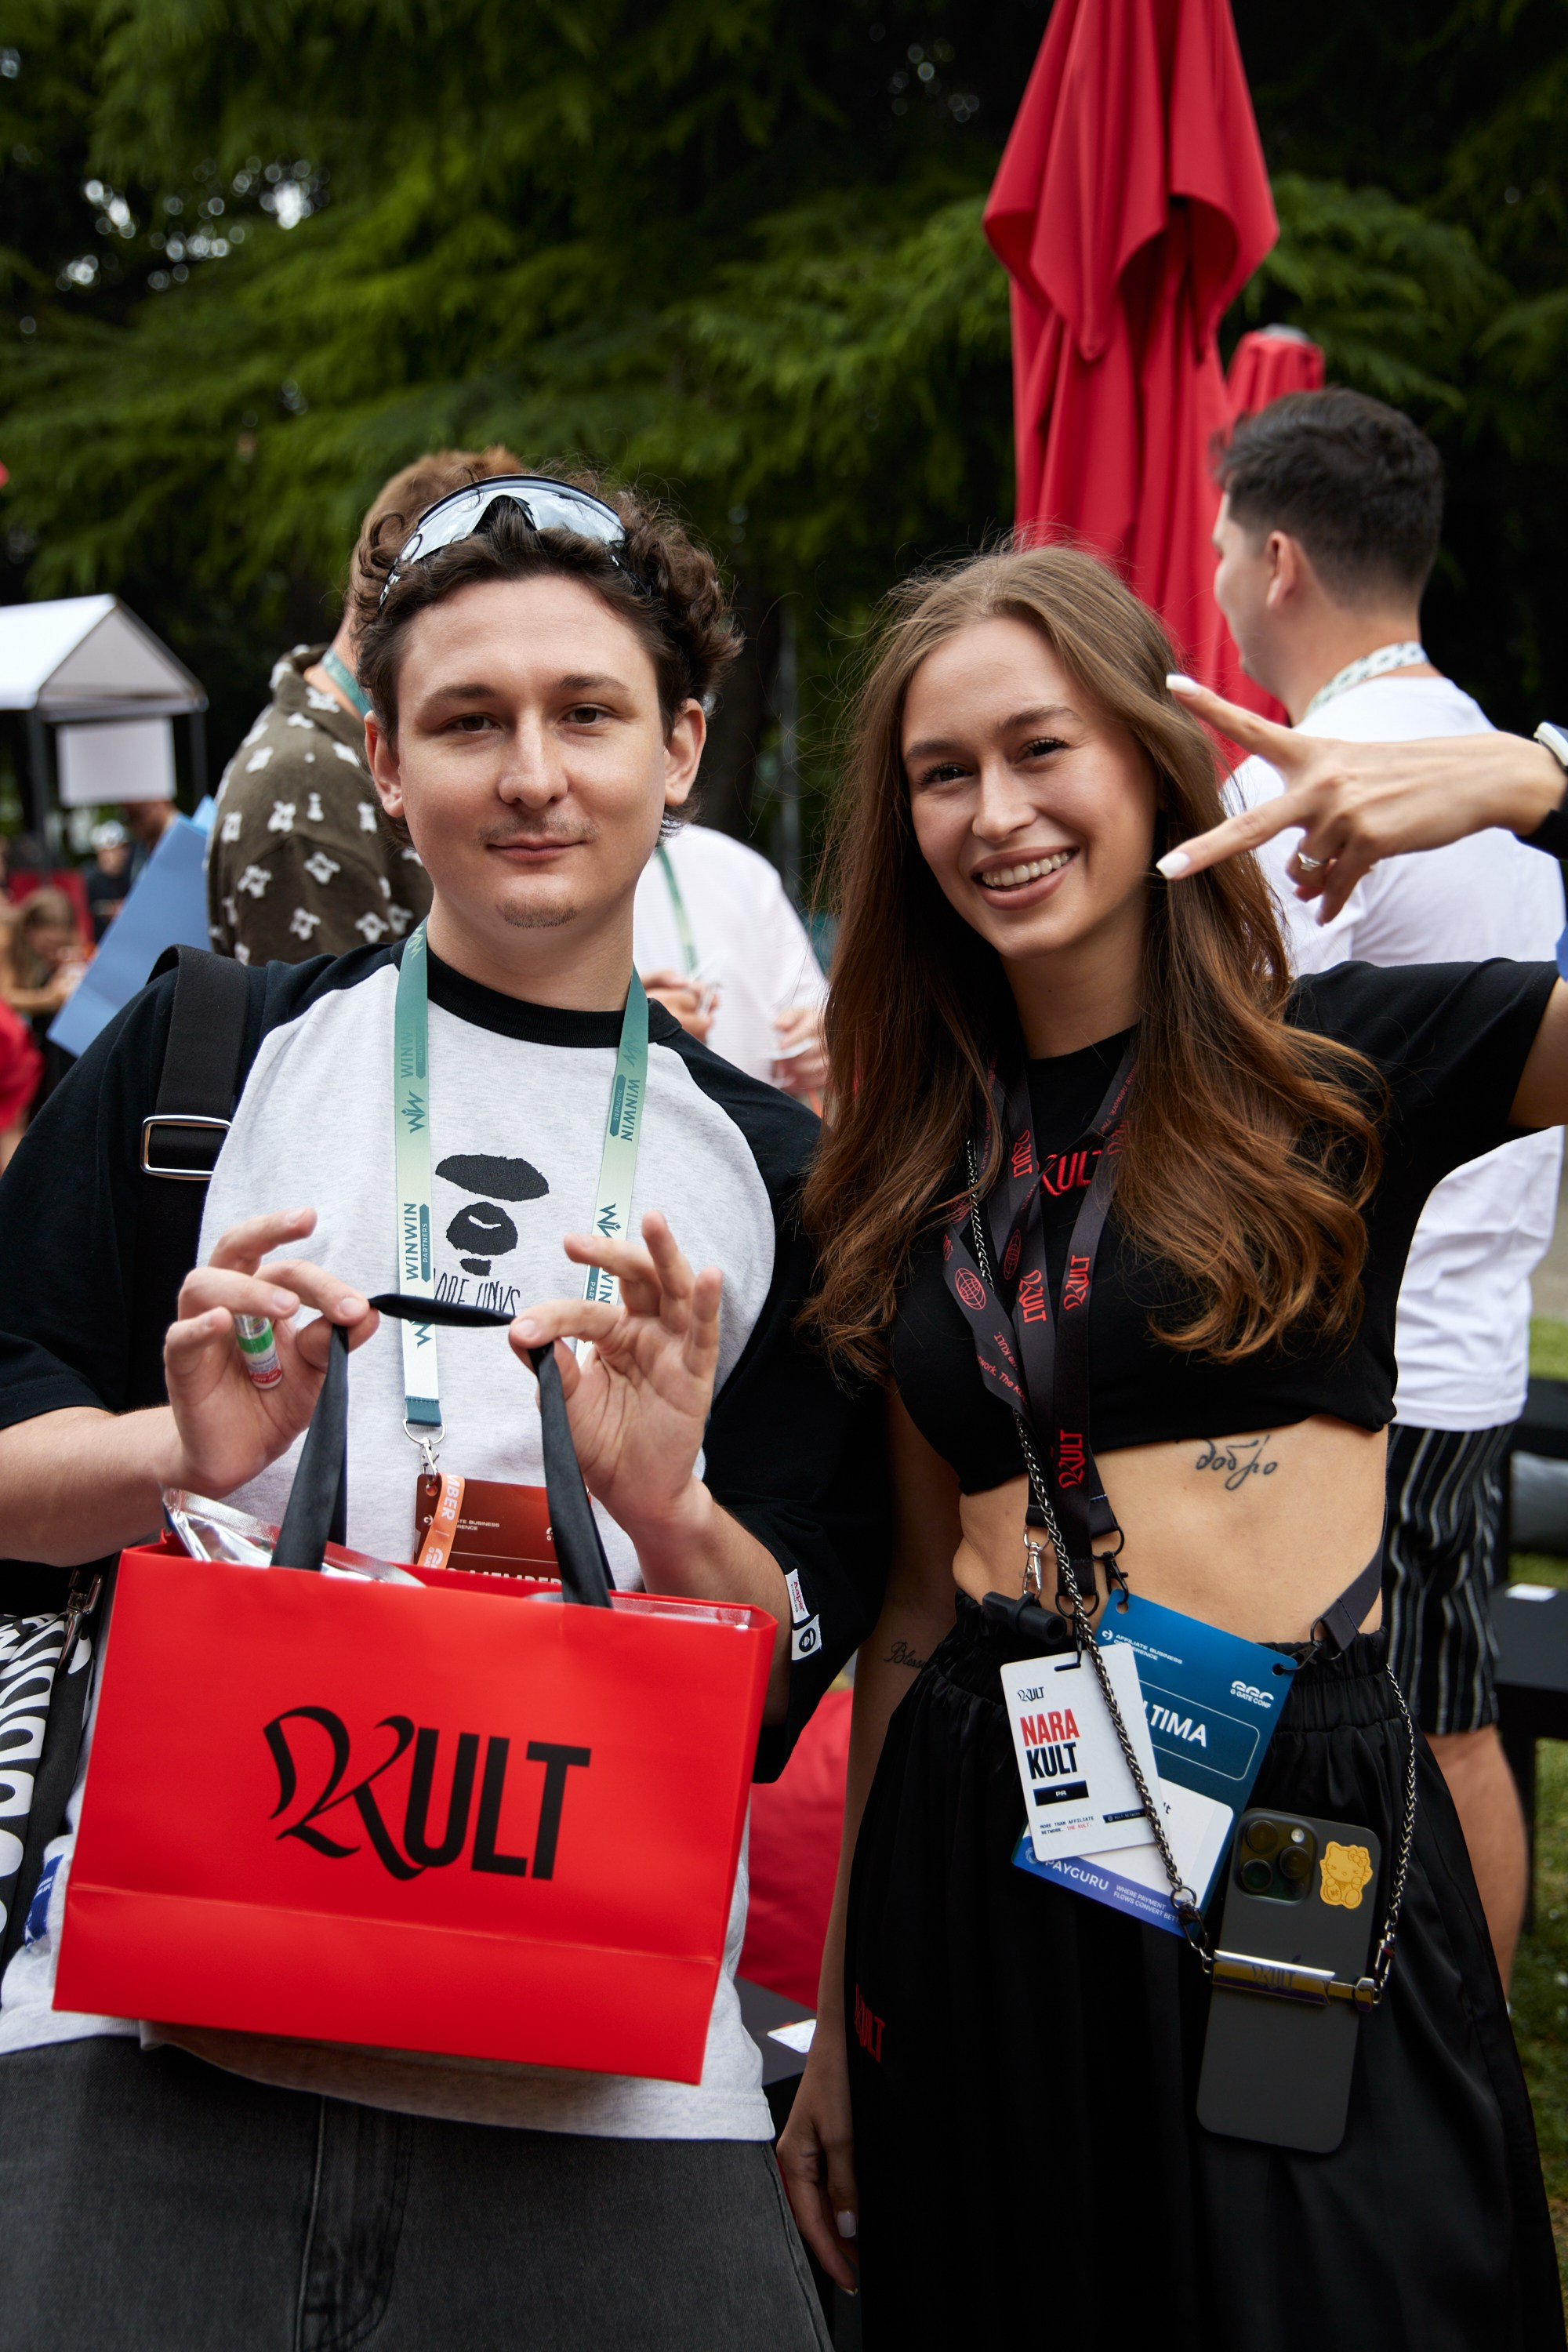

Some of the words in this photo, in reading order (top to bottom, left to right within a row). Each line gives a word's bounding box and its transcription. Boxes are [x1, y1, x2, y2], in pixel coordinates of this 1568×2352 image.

[613, 1089, 622, 1121] PARTNERS
[620, 1079, 641, 1142] WINWIN
[404, 1203, 419, 1281] WINWIN
[1018, 1269, 1047, 1323] KULT
[1063, 1254, 1090, 1311] KULT
[999, 1371, 1014, 1388] The
[1058, 1429, 1086, 1489] KULT
[1116, 1634, 1149, 1650] AFFILIATE
[1149, 1647, 1183, 1664] BUSINESS
[1017, 1686, 1044, 1702] KULT
[1236, 1691, 1254, 1702] GATE
[1253, 1697, 1272, 1708] CONF
[1019, 1708, 1080, 1747] NARA
[1025, 1741, 1078, 1780] KULT
[263, 1705, 592, 1882] KULT
[1068, 1816, 1094, 1824] AFFILIATE
[1113, 1890, 1135, 1904] FLOWS
[1134, 1900, 1164, 1916] CONVERT
[1116, 1885, 1138, 1899] WHERE
[1138, 1893, 1167, 1910] PAYMENT
